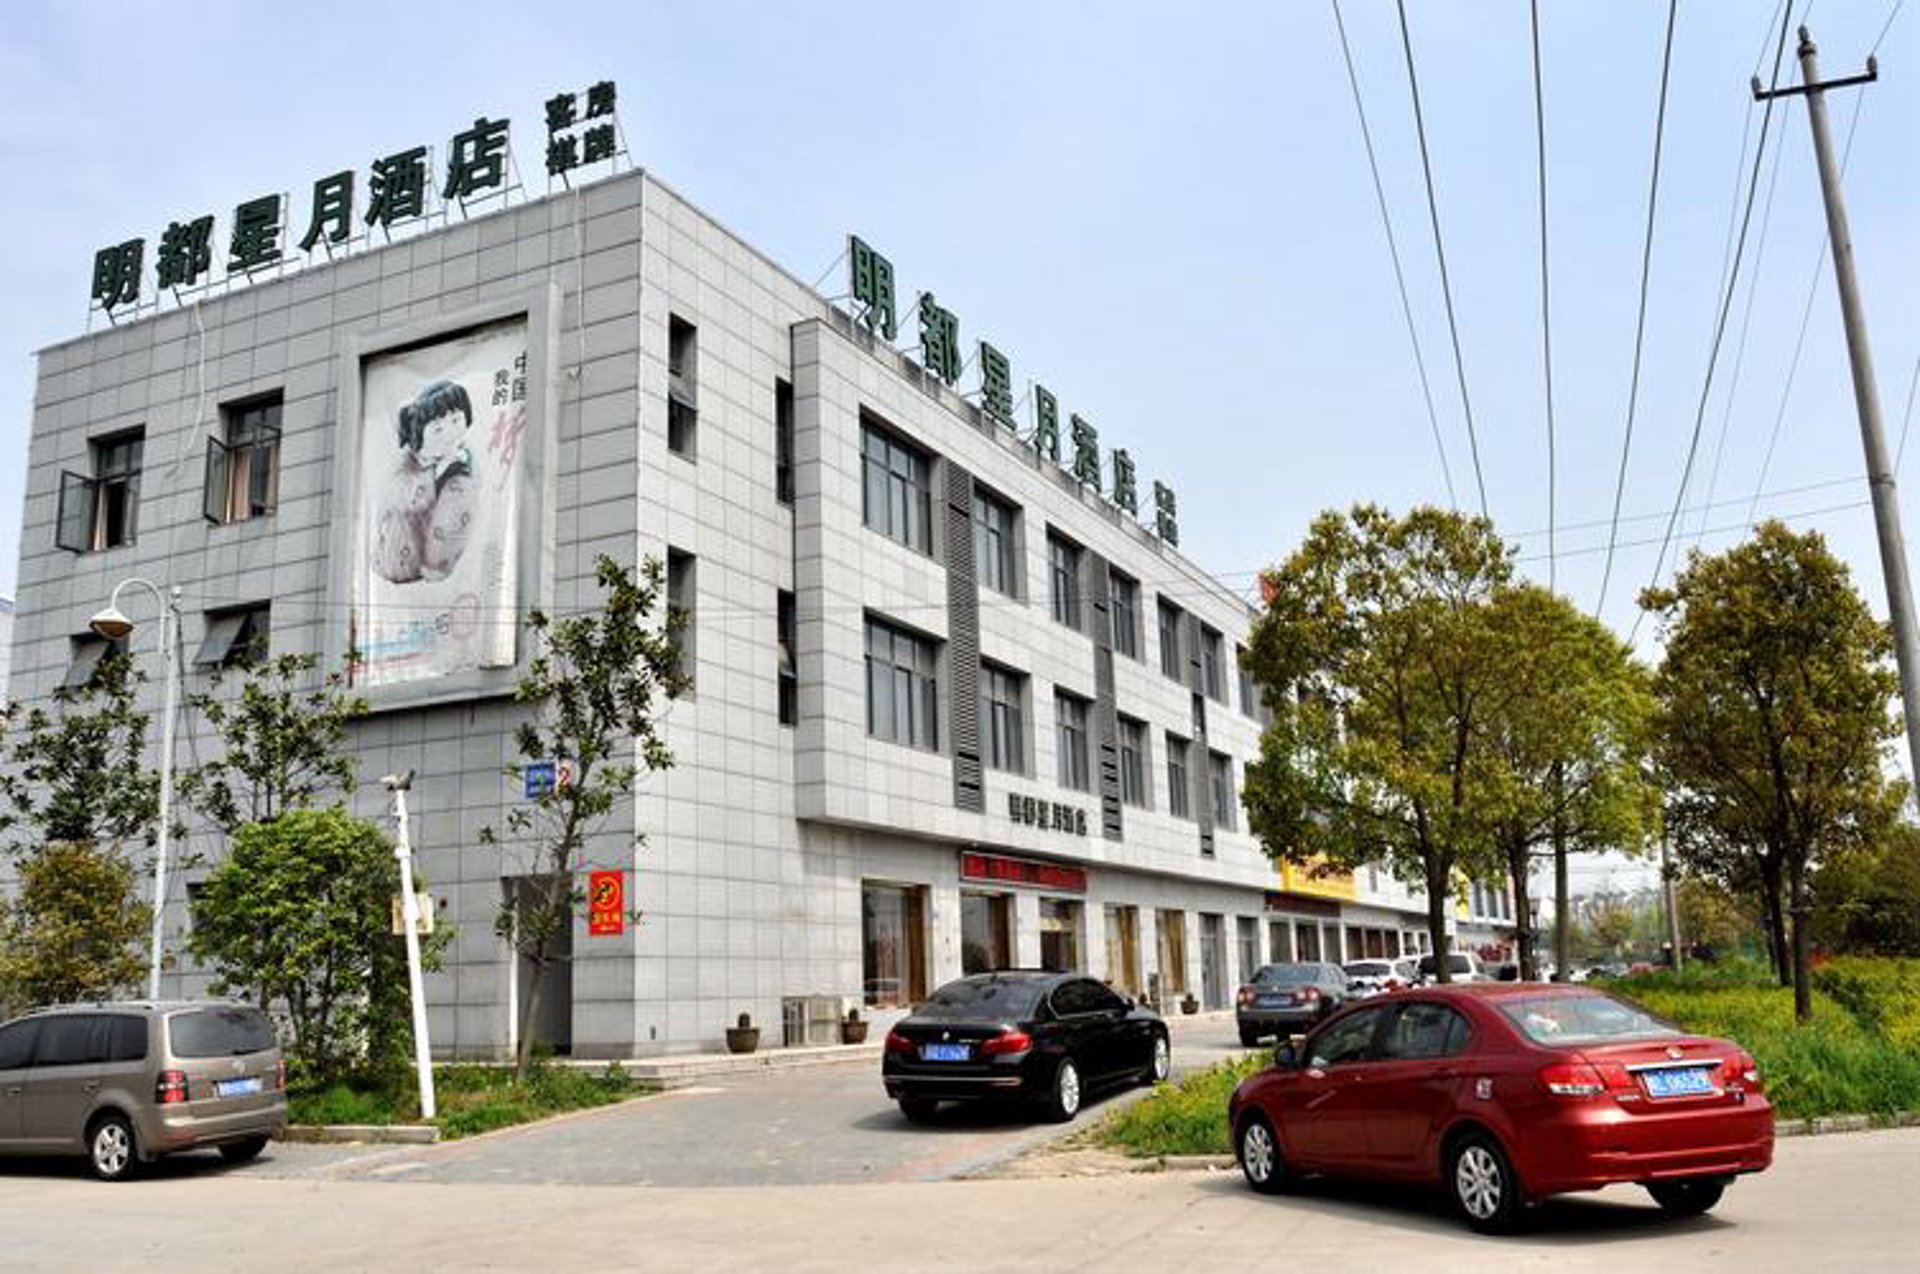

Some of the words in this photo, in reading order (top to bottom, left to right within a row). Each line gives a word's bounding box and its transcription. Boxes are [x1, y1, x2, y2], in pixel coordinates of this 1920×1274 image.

[91, 116, 510, 310] 明都星月酒店
[850, 234, 1138, 518] 明都星月酒店
